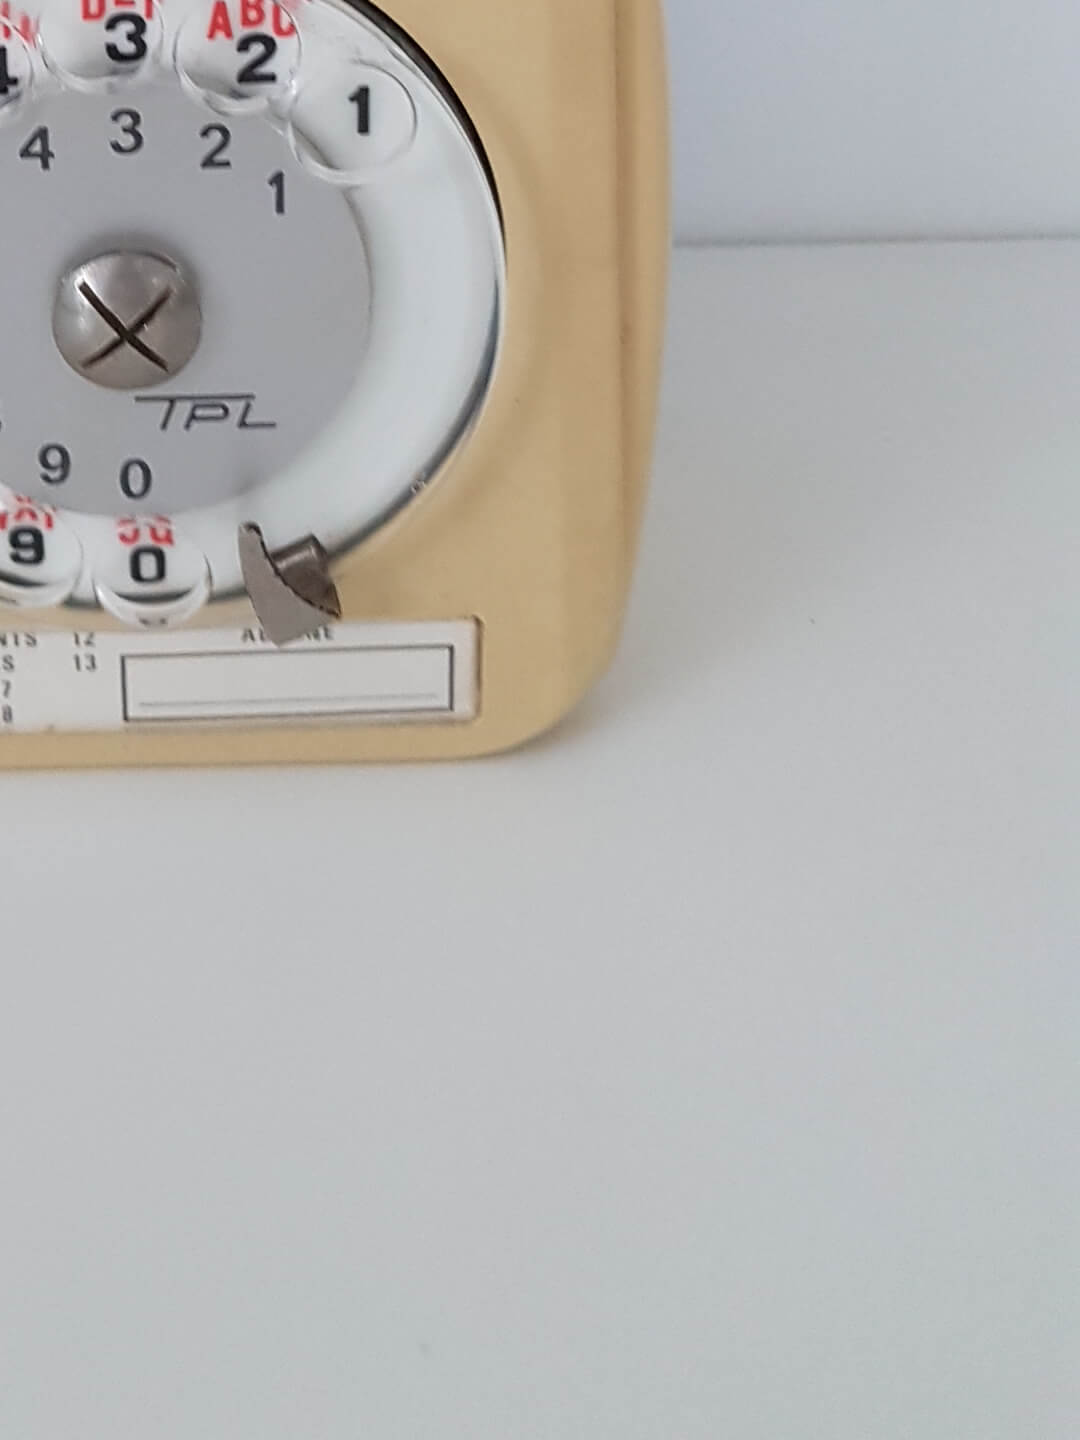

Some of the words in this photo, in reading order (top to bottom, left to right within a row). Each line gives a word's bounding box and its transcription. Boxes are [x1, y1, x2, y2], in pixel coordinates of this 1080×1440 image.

[105, 13, 148, 64] 3
[236, 33, 277, 83] 2
[109, 108, 143, 154] 3
[348, 85, 370, 136] 1
[19, 126, 54, 171] 4
[200, 123, 231, 169] 2
[267, 170, 285, 215] 1
[134, 394, 276, 430] TPL
[38, 443, 71, 485] 9
[120, 459, 152, 499] 0
[9, 526, 45, 564] 9
[130, 546, 166, 583] 0
[73, 654, 97, 672] 13
